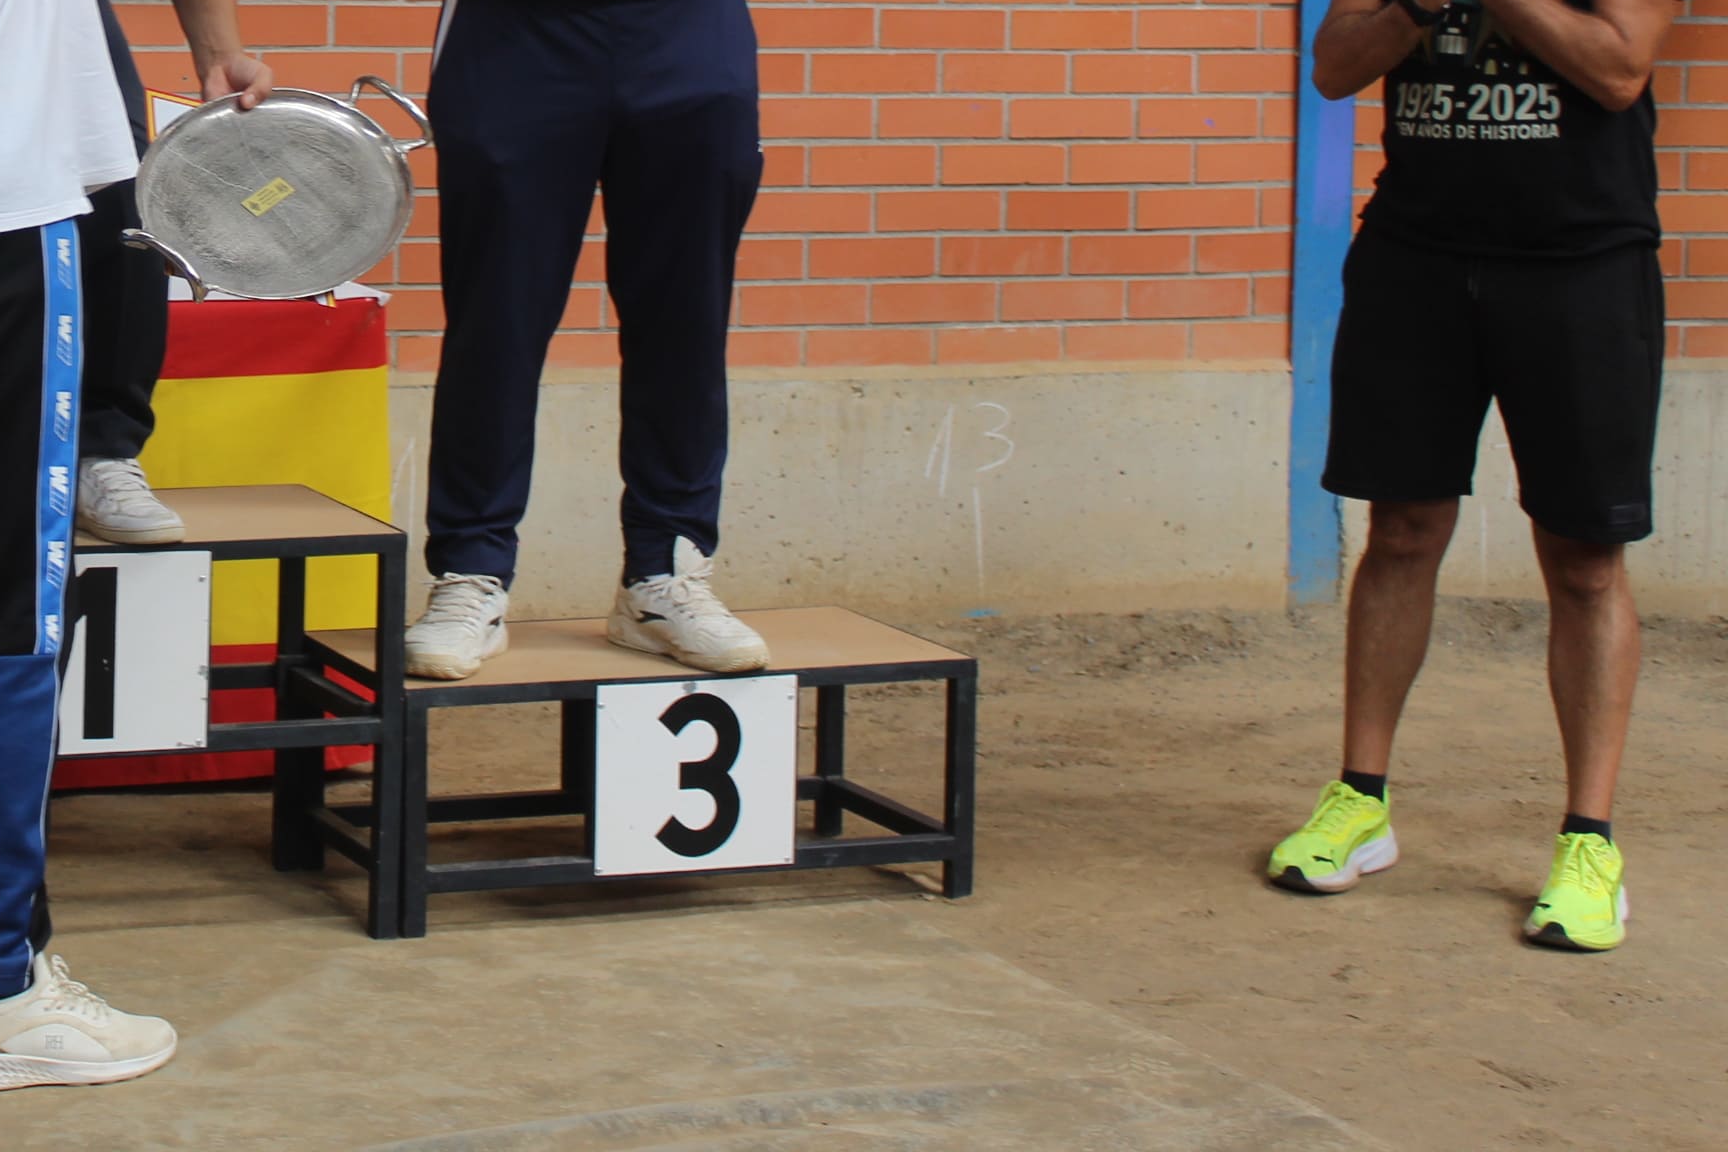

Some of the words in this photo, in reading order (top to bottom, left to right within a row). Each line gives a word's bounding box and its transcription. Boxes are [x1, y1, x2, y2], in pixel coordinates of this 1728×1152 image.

[1395, 83, 1561, 122] 1925-2025
[1455, 124, 1476, 139] DE
[1480, 124, 1561, 140] HISTORIA
[73, 566, 118, 739] 1
[655, 692, 742, 858] 3
